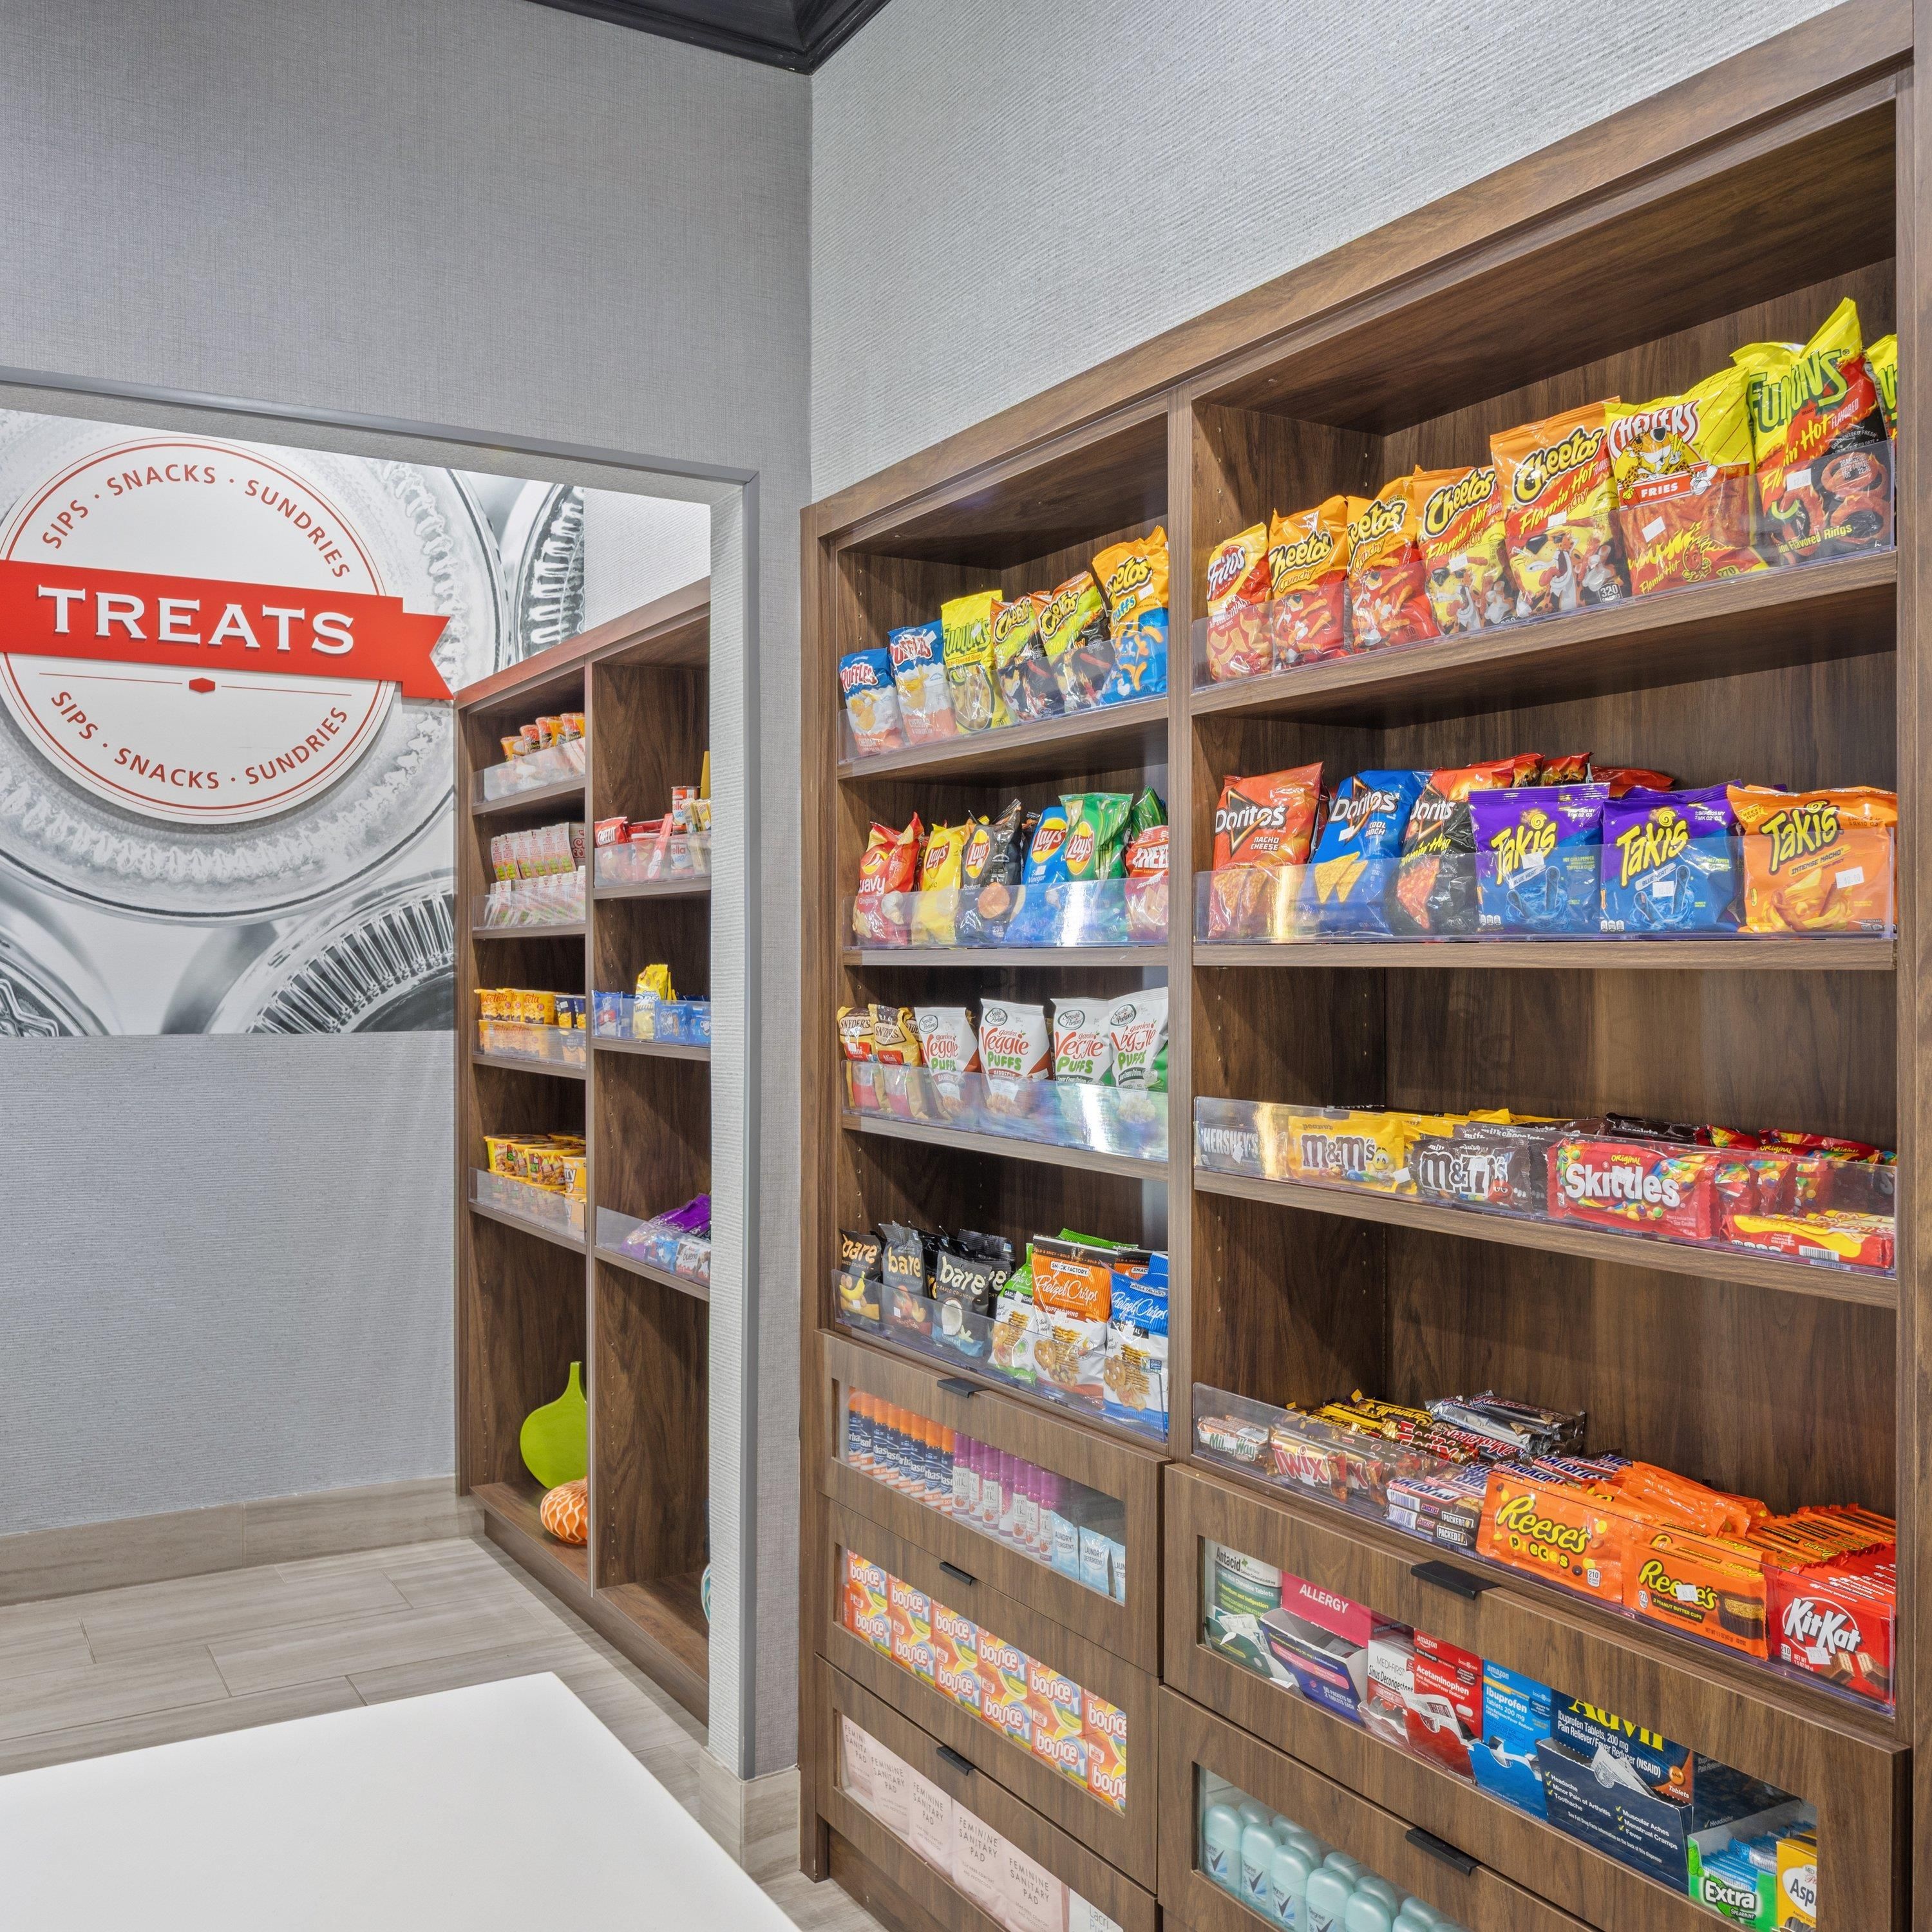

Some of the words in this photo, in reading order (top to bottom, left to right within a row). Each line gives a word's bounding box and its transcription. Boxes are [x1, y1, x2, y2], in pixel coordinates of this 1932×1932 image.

[1832, 398, 1860, 429] FLAVORED
[1801, 413, 1835, 450] Hot
[1832, 431, 1861, 450] GUARANTEED
[1861, 430, 1877, 438] FRESH
[1514, 426, 1606, 505] Cheetos
[1571, 461, 1598, 493] Hot
[1424, 469, 1497, 537] Cheetos
[1641, 482, 1678, 498] FRIES
[43, 500, 89, 549] SIPS
[107, 464, 216, 497] SNACKS
[245, 479, 350, 578] SUNDRIES
[1470, 503, 1491, 531] Hot
[1788, 532, 1821, 551] Flavored
[1824, 524, 1853, 540] Rings
[1207, 546, 1246, 601] Fritos
[1278, 567, 1315, 593] Crunchy
[1718, 567, 1737, 578] 270
[1600, 584, 1619, 598] 320
[38, 585, 354, 654] TREATS
[840, 663, 878, 692] RUFFLES
[52, 691, 99, 740] SIPS
[115, 747, 219, 790] SNACKS
[245, 707, 347, 785] SUNDRIES
[1215, 803, 1287, 834] Doritos
[1331, 790, 1398, 822] Doritos
[1032, 828, 1066, 857] Lay's
[1066, 833, 1094, 862] Lay's
[1250, 843, 1278, 851] CHEESE
[1491, 813, 1558, 886] Takis
[1616, 808, 1689, 887] Takis
[1761, 800, 1838, 872] Takis
[926, 841, 951, 869] Lay's
[1792, 859, 1819, 875] INTENSE
[1820, 849, 1842, 864] NACHO
[1513, 874, 1526, 886] BLUE
[1525, 869, 1540, 880] HEAT
[1642, 876, 1654, 886] BLUE
[923, 1034, 958, 1059] Veggie
[980, 1026, 1030, 1056] Veggie
[883, 1054, 898, 1063] Mini
[931, 1057, 956, 1071] PUFFS
[987, 1051, 1022, 1072] PUFFS
[1056, 1056, 1094, 1074] PUFFS
[1118, 1050, 1146, 1070] PUFFS
[1202, 1128, 1259, 1159] HERSHEY'S
[1565, 1163, 1681, 1208] Skittles
[842, 1234, 878, 1264] bare
[888, 1247, 922, 1277] bare
[851, 1262, 869, 1271] CRUNCHY
[942, 1256, 986, 1295] bare
[1067, 1266, 1088, 1275] FACTORY
[940, 1285, 952, 1294] BAKED
[952, 1290, 975, 1301] CRUNCHY
[1036, 1274, 1067, 1302] Pretzel
[1067, 1280, 1098, 1303] Crisps
[1136, 1298, 1168, 1323] Crisps
[1209, 1433, 1235, 1457] Mily
[1235, 1437, 1256, 1462] Way
[1443, 1513, 1462, 1527] PACKED
[1497, 1494, 1591, 1554] Reese's
[1439, 1528, 1458, 1542] PACKED
[1083, 1556, 1103, 1566] DETERGENT
[1084, 1547, 1103, 1557] LAUNDRY
[1216, 1546, 1242, 1572] Antacid
[851, 1560, 880, 1587] bounce
[1588, 1569, 1600, 1579] 210
[1639, 1559, 1718, 1611] Reee's
[892, 1584, 923, 1613] bounce
[1245, 1596, 1269, 1609] Indigestion
[1255, 1586, 1274, 1598] Tablets
[1299, 1584, 1350, 1615] ALLERGY
[855, 1609, 886, 1636] bounce
[1657, 1599, 1673, 1610] PEANUT
[1673, 1604, 1690, 1616] BUTTER
[1690, 1611, 1703, 1620] CUPS
[935, 1609, 970, 1641] bounce
[896, 1636, 929, 1666] bounce
[980, 1638, 1019, 1670] bounce
[1417, 1634, 1438, 1649] amazon
[1781, 1645, 1790, 1655] 210
[1368, 1665, 1380, 1680] Sinus
[1376, 1656, 1405, 1676] MEDI-FIRST
[1487, 1665, 1510, 1680] amazon
[939, 1664, 974, 1696] bounce
[1031, 1669, 1072, 1703] bounce
[1417, 1665, 1470, 1696] Acetaminophen
[1449, 1690, 1466, 1701] Reducer
[1486, 1686, 1528, 1714] Ibuprofen
[985, 1695, 1023, 1728] bounce
[1088, 1701, 1126, 1737] bounce
[1486, 1698, 1503, 1711] Tablets
[1504, 1707, 1515, 1716] 200
[1516, 1713, 1525, 1722] mg
[1558, 1710, 1584, 1730] Ibuprofen
[1584, 1722, 1606, 1741] Tablets,
[1607, 1734, 1618, 1747] 200
[1619, 1741, 1629, 1753] mg
[855, 1750, 867, 1764] PAD
[1036, 1728, 1078, 1764] bounce
[1558, 1720, 1570, 1734] Pain
[1611, 1746, 1636, 1765] Reducer
[1636, 1758, 1662, 1779] (NSAID)
[871, 1757, 904, 1777] FEMININE
[873, 1767, 905, 1788] SANITARY
[884, 1781, 898, 1794] PAD
[1551, 1774, 1578, 1792] Headache
[1669, 1785, 1690, 1799] Tablets
[913, 1782, 943, 1812] FEMININE
[913, 1793, 944, 1823] SANITARY
[1552, 1784, 1569, 1795] Minor
[1569, 1792, 1582, 1802] Pain
[1589, 1802, 1611, 1817] Arthritis
[1554, 1792, 1584, 1812] Toothache
[922, 1811, 934, 1826] PAD
[959, 1816, 998, 1848] FEMININE
[1589, 1821, 1598, 1832] Facts
[1598, 1825, 1616, 1841] information
[1622, 1810, 1650, 1828] Muscular
[1650, 1823, 1670, 1837] Aches
[1709, 1815, 1734, 1828] Headache
[959, 1828, 998, 1859] SANITARY
[1624, 1819, 1654, 1839] Menstrual
[1653, 1833, 1678, 1850] Cramps
[1625, 1828, 1643, 1842] Fever
[970, 1846, 986, 1862] PAD
[1009, 1857, 1049, 1893] FEMININE
[1010, 1869, 1049, 1902] SANITARY
[1023, 1888, 1039, 1905] PAD
[1706, 1879, 1755, 1909] Extra
[1790, 1878, 1817, 1907] Asp
[1309, 1906, 1325, 1922] Degree
[1730, 1908, 1756, 1920] SPEARMINT
